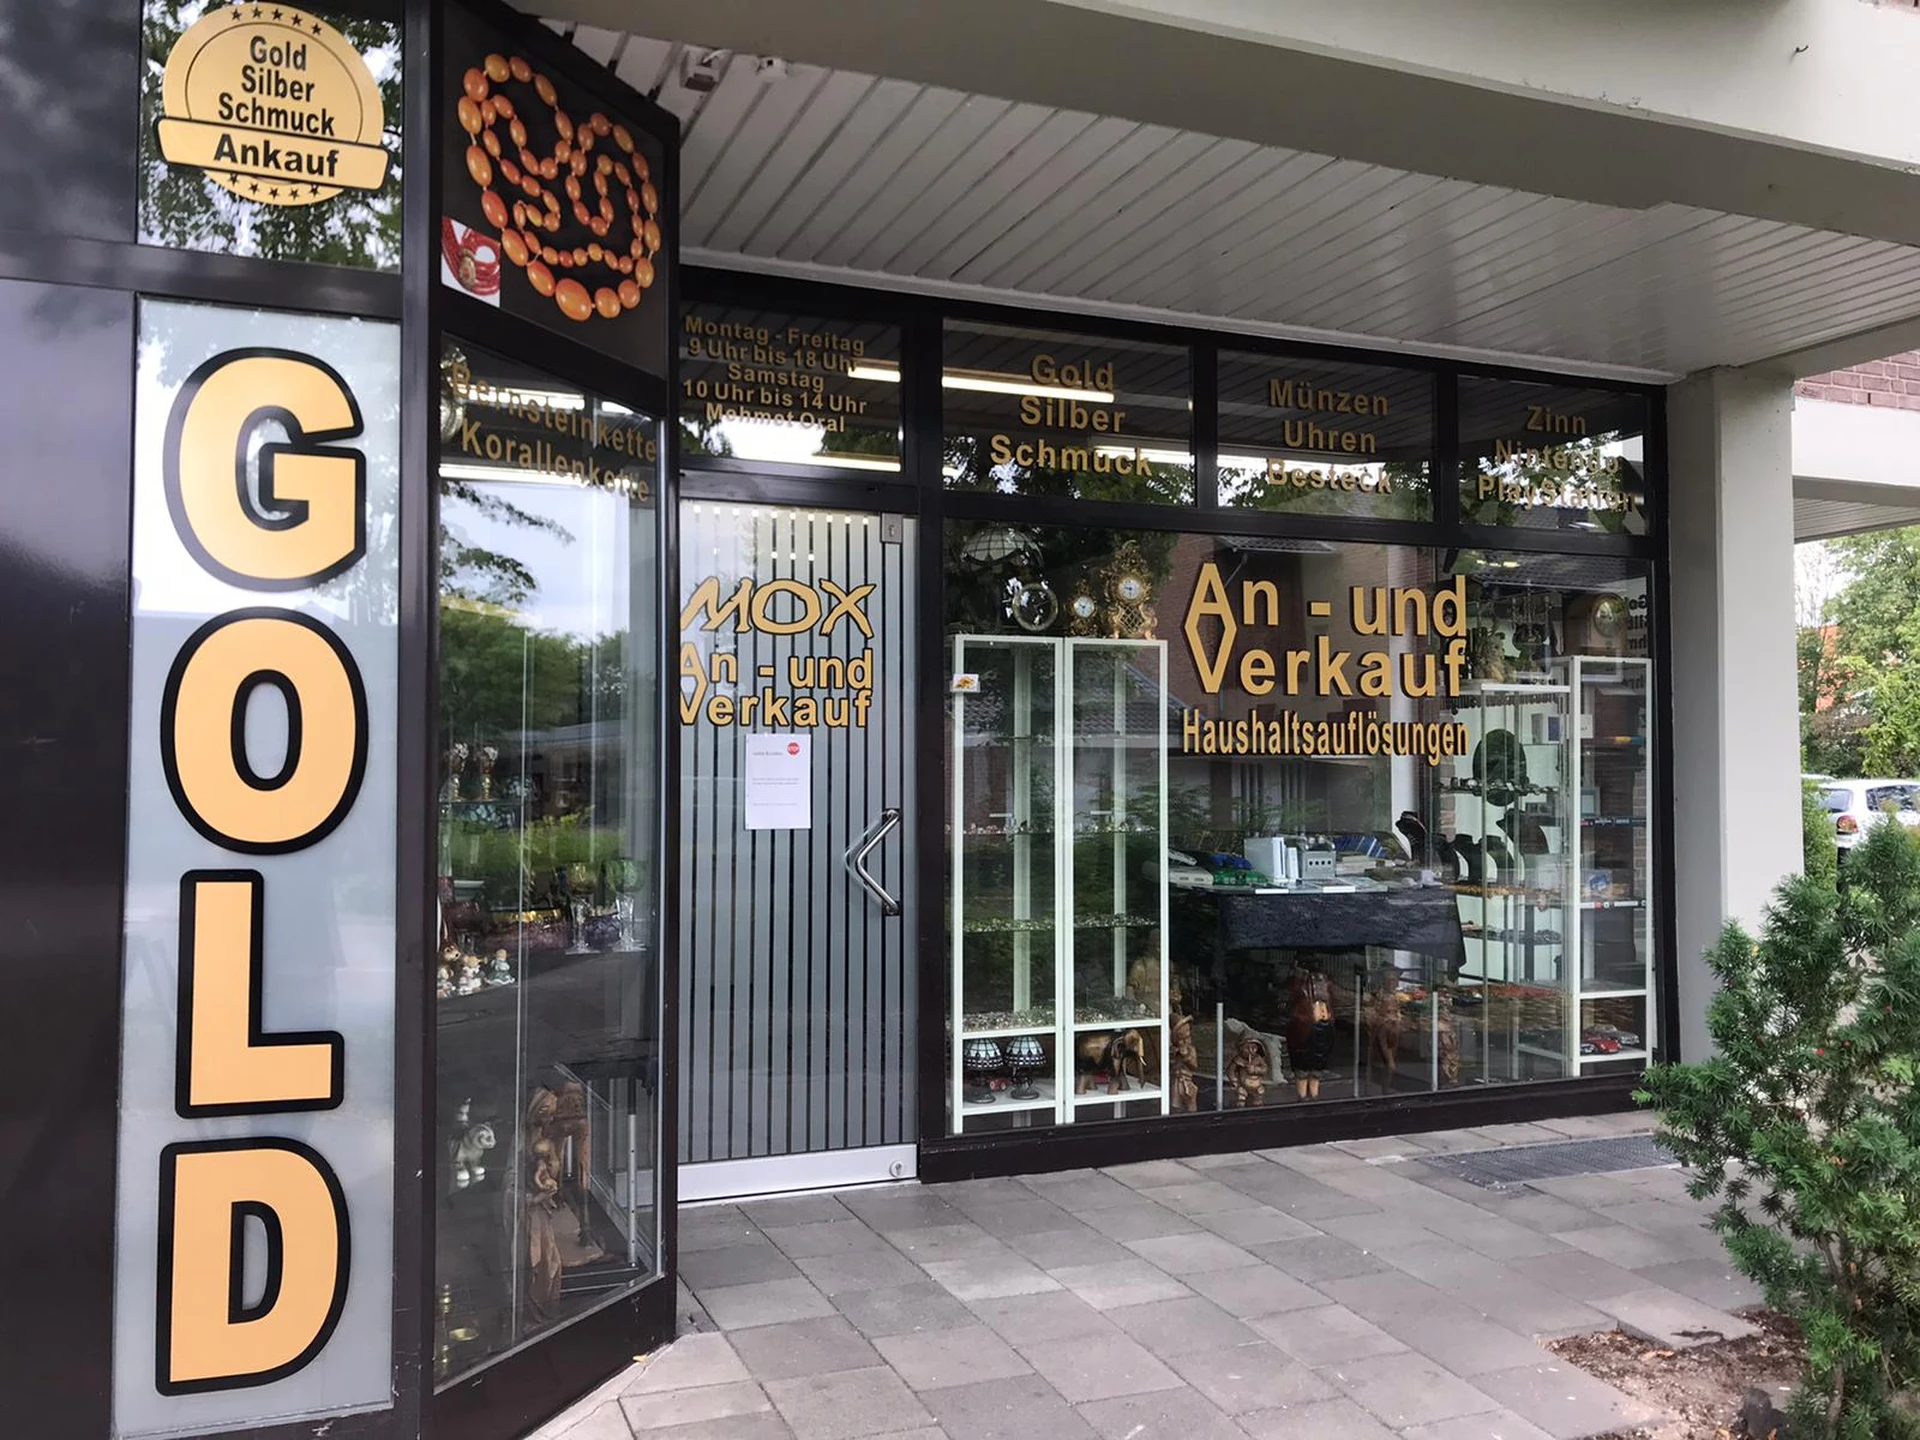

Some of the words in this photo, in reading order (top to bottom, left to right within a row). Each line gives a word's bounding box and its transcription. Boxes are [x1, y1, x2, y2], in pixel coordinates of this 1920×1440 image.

[250, 35, 307, 71] Gold
[241, 65, 315, 102] Silber
[218, 92, 335, 136] Schmuck
[213, 133, 340, 177] Ankauf
[684, 315, 769, 347] Montag
[787, 328, 865, 357] Freitag
[689, 339, 701, 355] 9
[707, 340, 748, 361] Uhr
[753, 346, 787, 366] bis
[793, 349, 816, 368] 18
[823, 353, 860, 373] Uhr
[1031, 354, 1114, 391] Gold
[683, 379, 708, 398] 10
[714, 381, 754, 403] Uhr
[760, 387, 793, 408] bis
[800, 391, 823, 410] 14
[829, 395, 867, 415] Uhr
[728, 363, 825, 393] Samstag
[1269, 378, 1389, 416] Münzen
[451, 361, 657, 463] Bernsteinkette
[706, 402, 794, 428] Mehmet
[799, 411, 846, 433] Oral
[1019, 395, 1126, 433] Silber
[1526, 405, 1586, 434] Zinn
[990, 433, 1152, 477] Schmuck
[1283, 420, 1376, 454] Uhren
[462, 417, 650, 502] Korallenkette
[1495, 438, 1619, 475] Nintendo
[1266, 458, 1392, 494] Besteck
[1478, 475, 1636, 512] PlayStation
[1184, 562, 1280, 627] An
[1350, 574, 1467, 637] und
[680, 640, 739, 685] An
[788, 647, 873, 690] und
[1184, 627, 1467, 698] Verkauf
[680, 680, 872, 727] Verkauf
[1182, 708, 1469, 767] Haushaltsauflösungen
[156, 346, 369, 1397] GOLD
